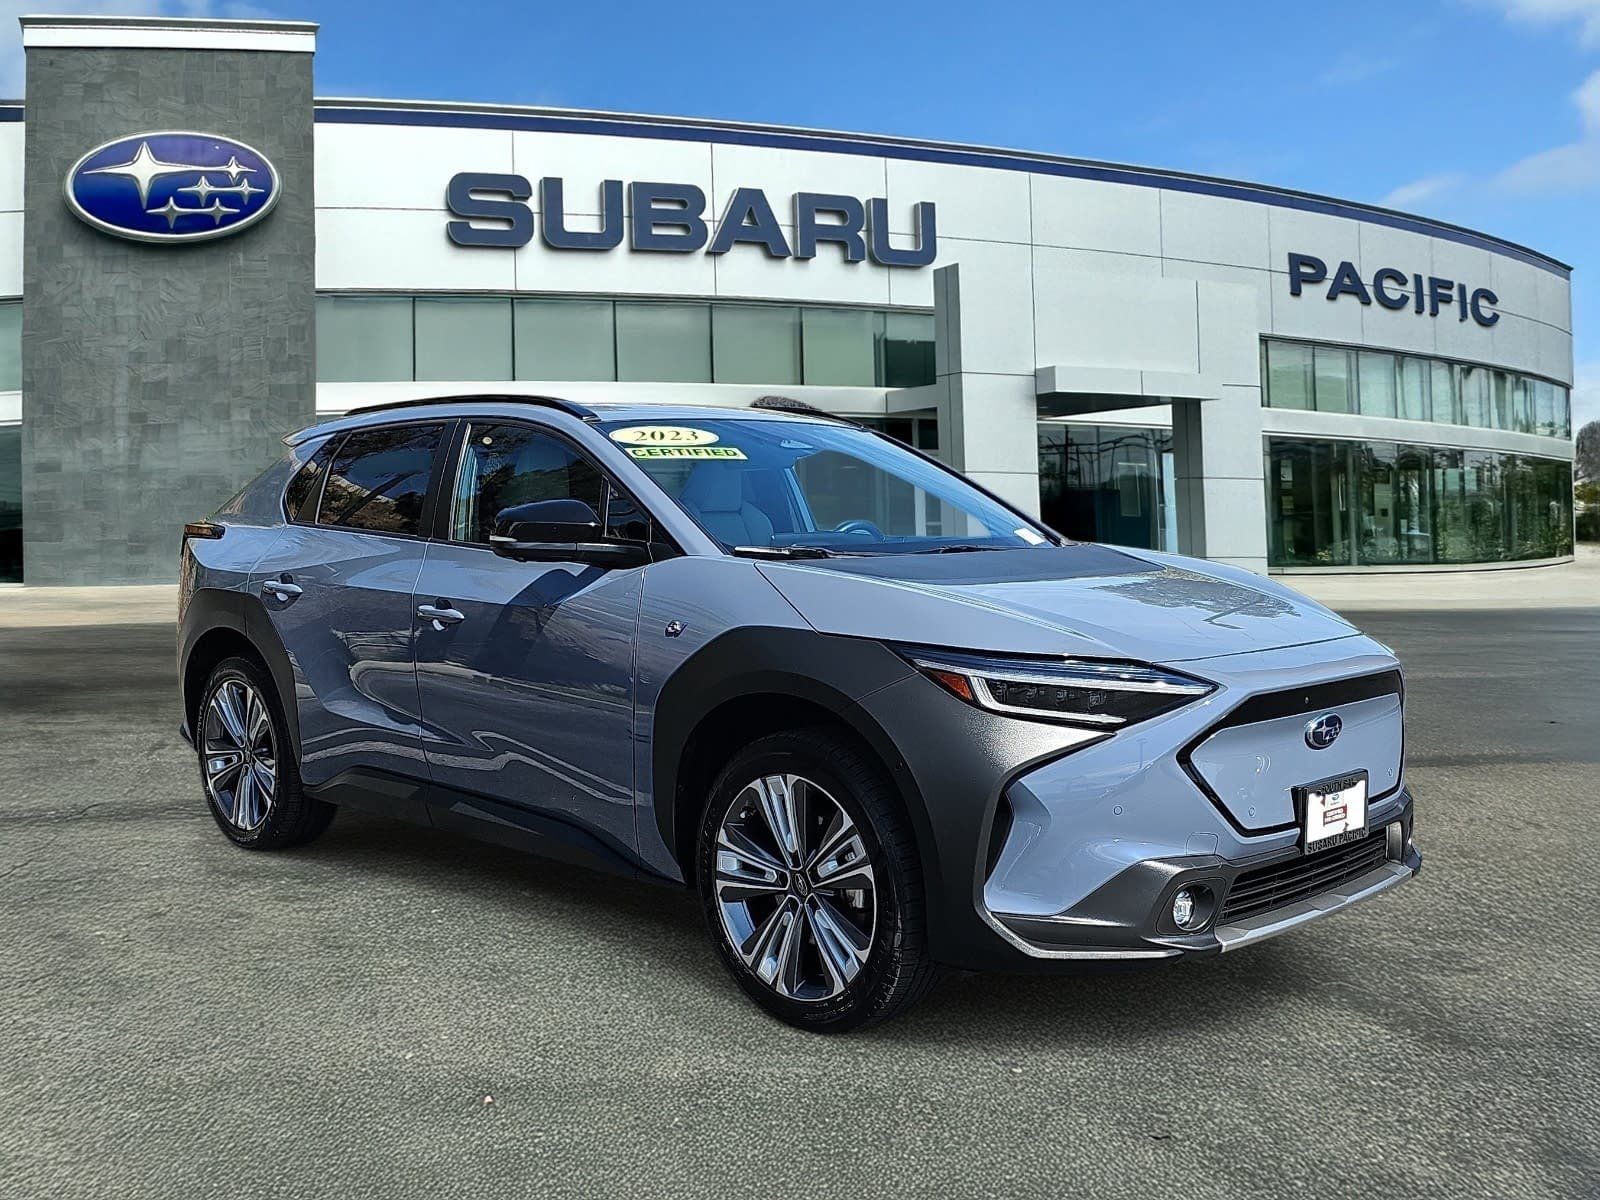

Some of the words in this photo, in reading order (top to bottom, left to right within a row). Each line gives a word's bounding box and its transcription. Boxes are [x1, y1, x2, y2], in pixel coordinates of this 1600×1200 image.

[447, 171, 936, 268] SUBARU
[1287, 252, 1500, 327] PACIFIC
[631, 448, 738, 458] CERTIFIED
[633, 430, 699, 441] 2023
